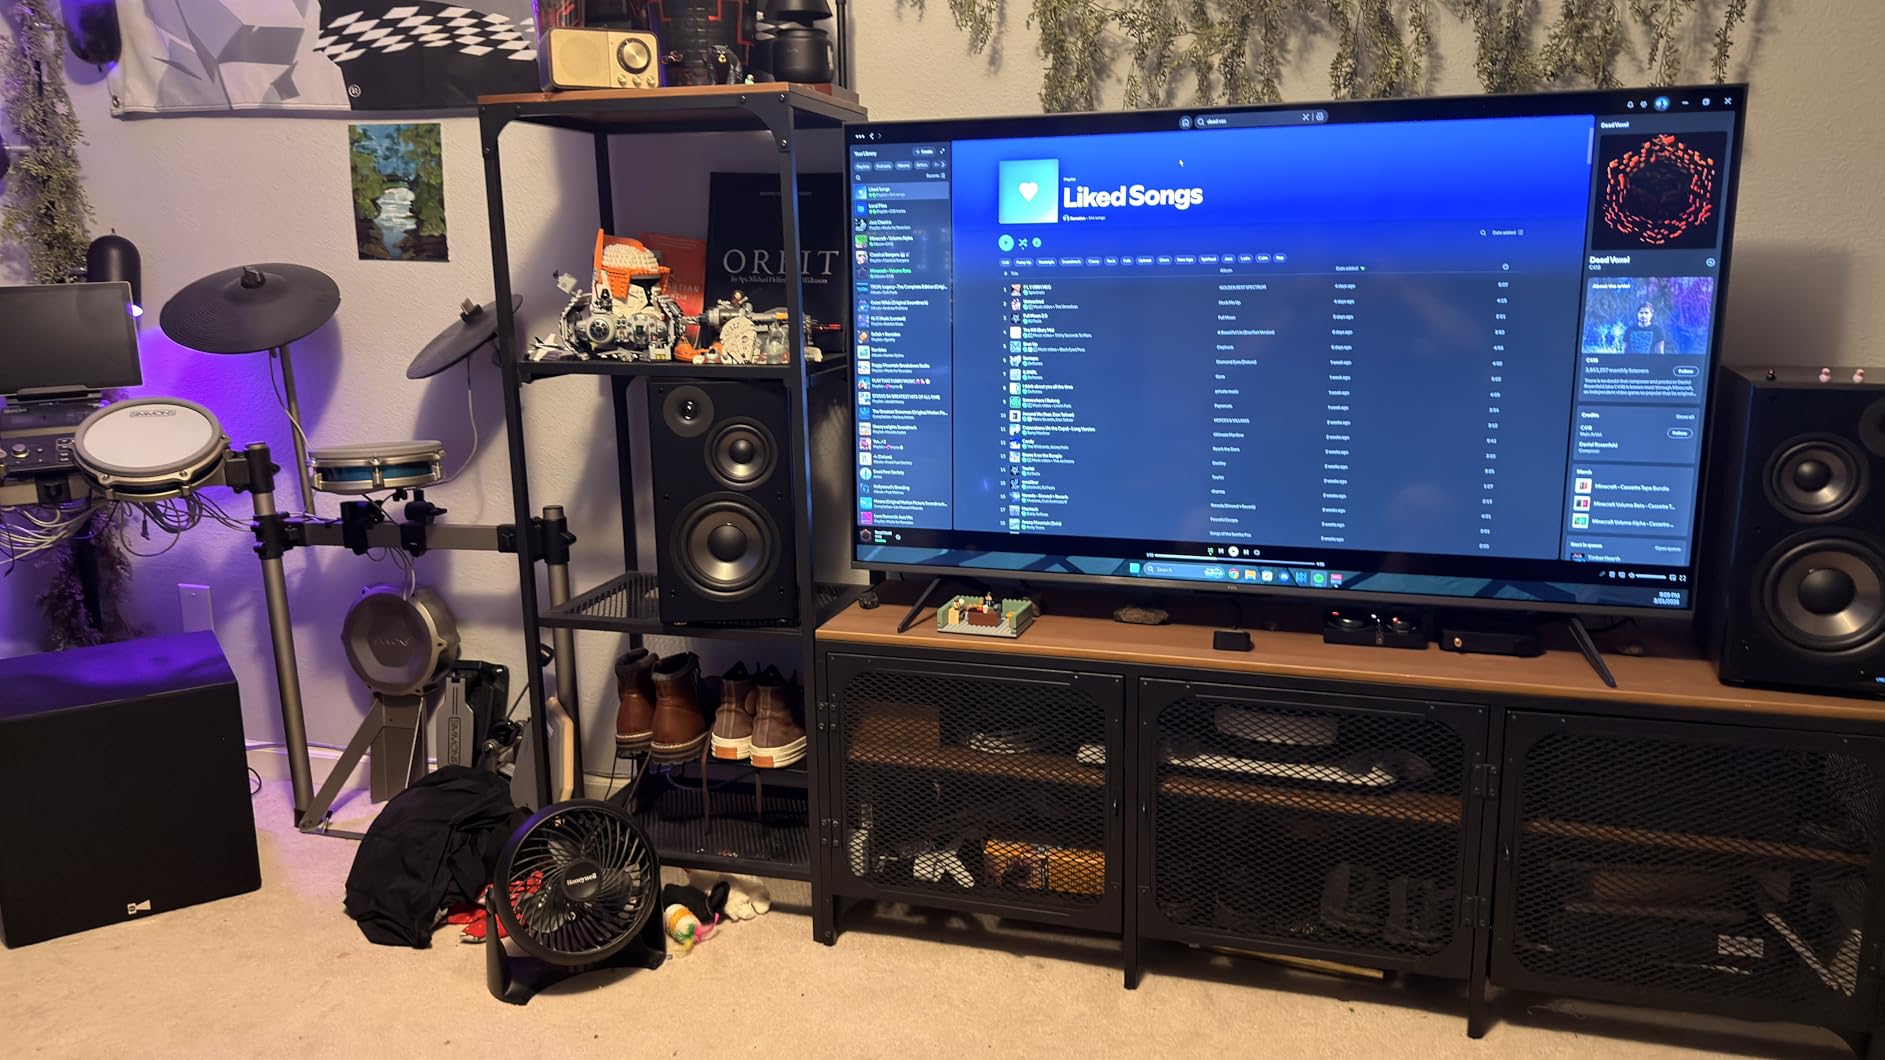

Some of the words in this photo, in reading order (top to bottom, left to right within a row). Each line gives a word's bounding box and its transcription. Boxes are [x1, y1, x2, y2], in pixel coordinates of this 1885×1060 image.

[1063, 185, 1127, 208] Liked
[1129, 184, 1203, 210] Songs
[567, 872, 597, 887] Honeywell
